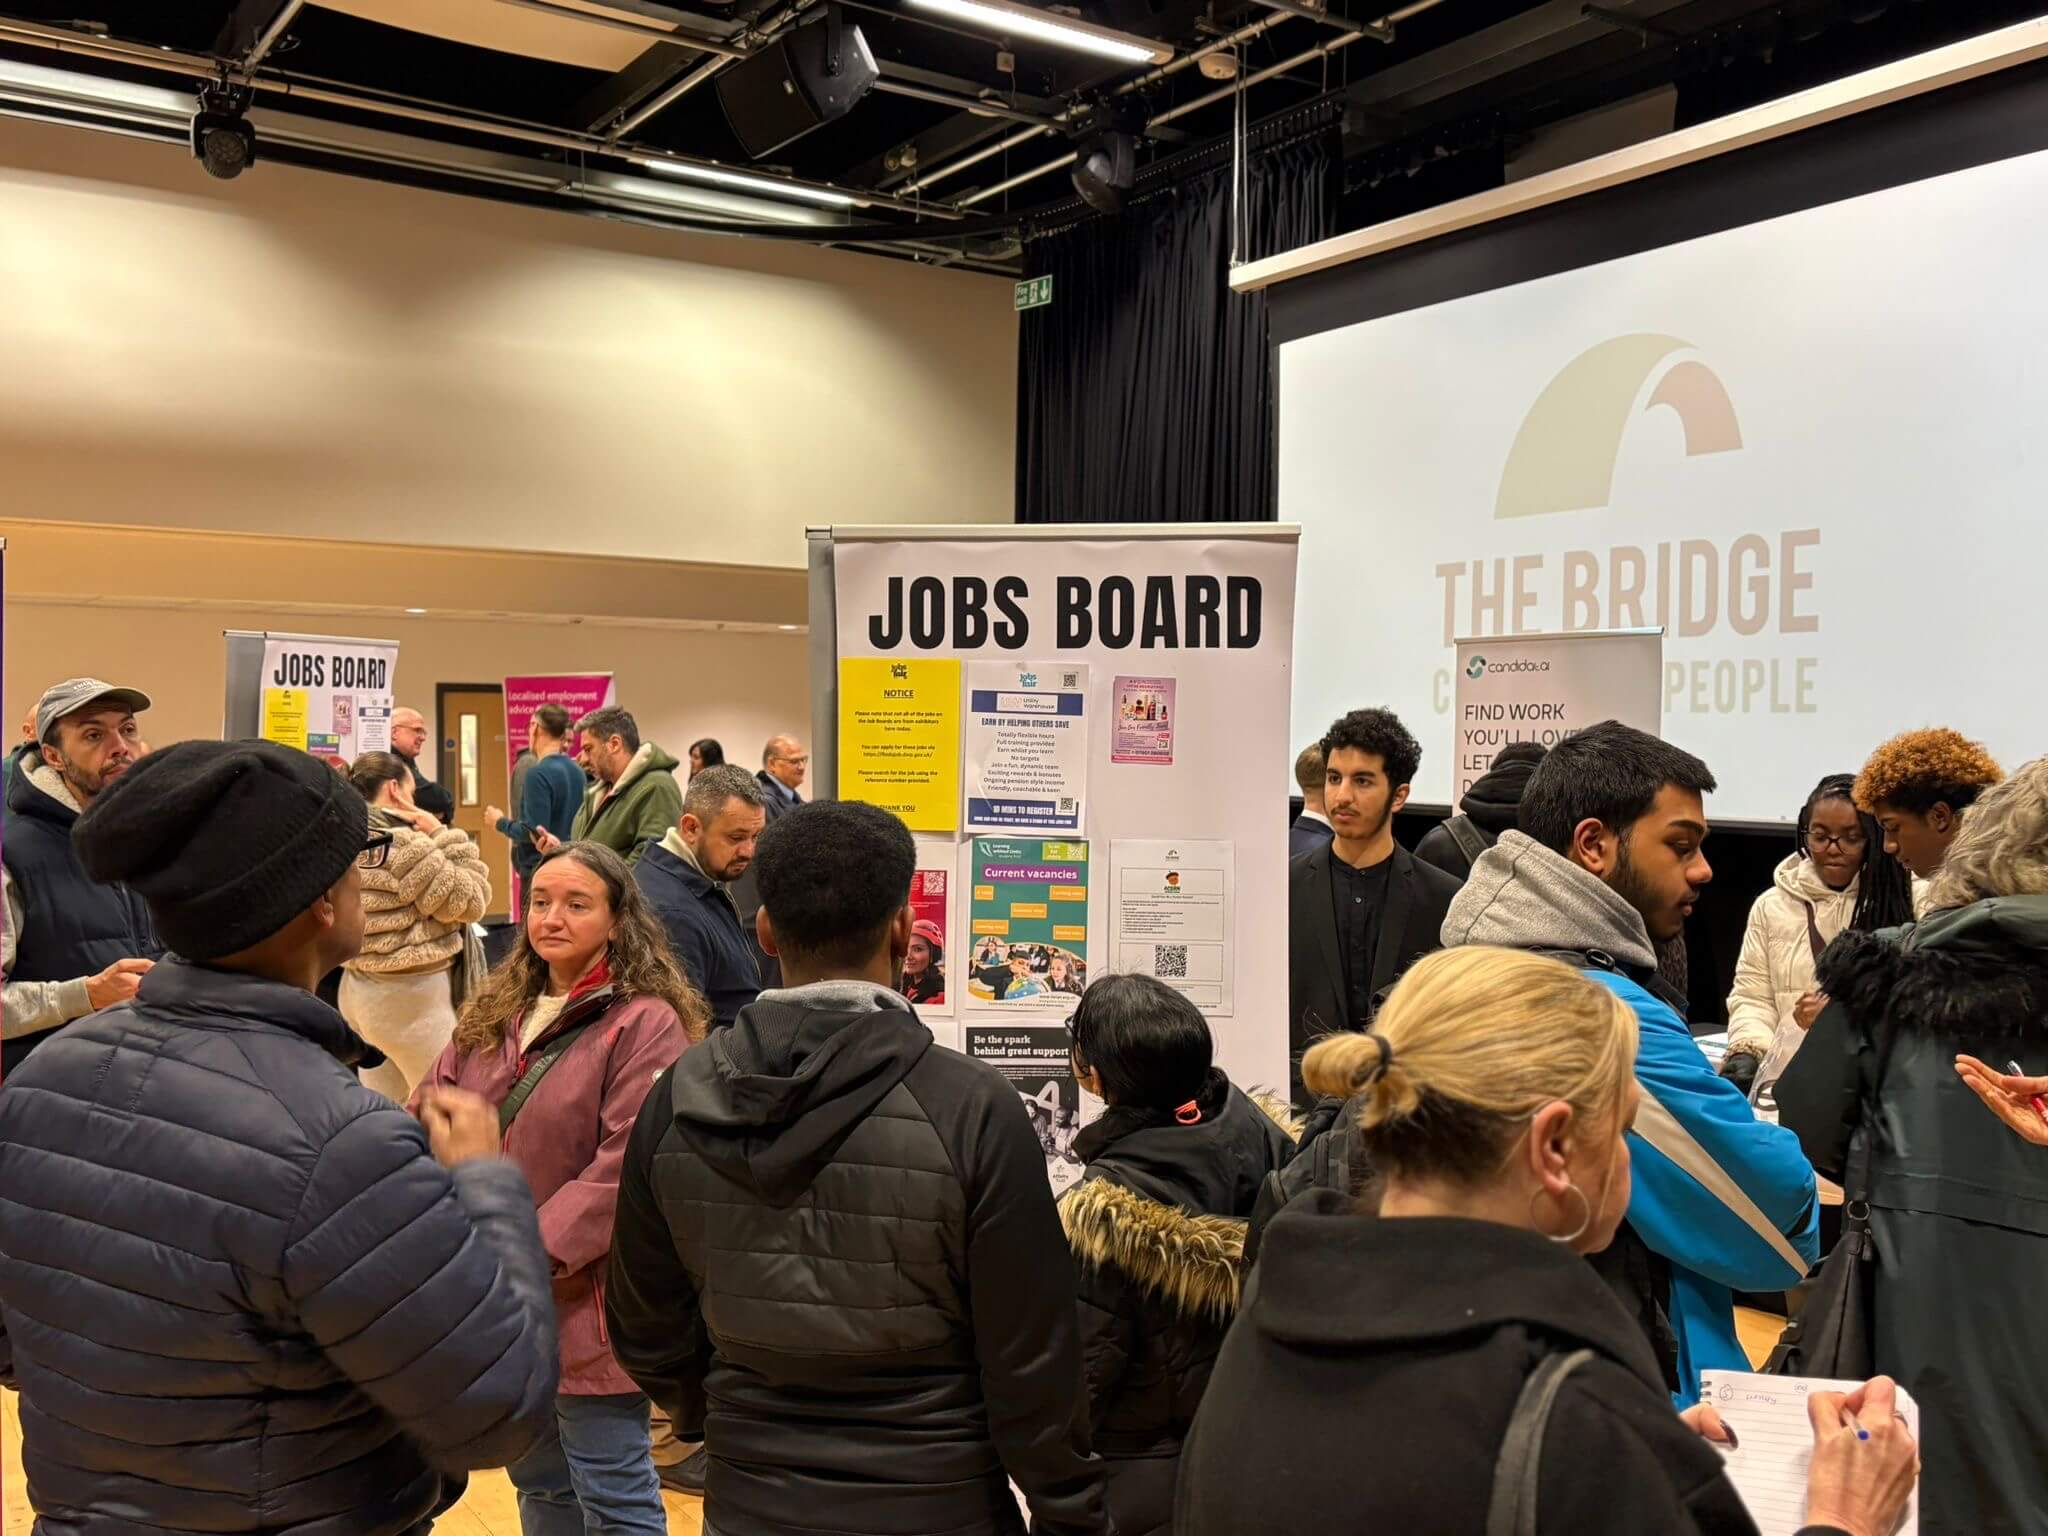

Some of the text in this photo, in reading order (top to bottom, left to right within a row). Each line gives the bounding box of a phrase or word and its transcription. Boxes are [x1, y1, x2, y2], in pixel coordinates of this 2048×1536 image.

[1435, 528, 1820, 648] THE BRIDGE
[868, 575, 1262, 649] JOBS BOARD
[274, 653, 386, 689] JOBS BOARD
[1664, 657, 1817, 713] PEOPLE
[508, 690, 598, 703] Localised employment
[509, 704, 534, 714] advice
[1464, 704, 1565, 720] FIND WORK
[982, 718, 996, 726] EARN
[1007, 719, 1030, 727] HELPING
[1032, 720, 1053, 728] OTHERS
[1018, 806, 1025, 814] TO
[1026, 807, 1053, 815] REGISTER
[985, 868, 1077, 879] Current vacancies
[988, 1035, 1001, 1044] the
[1004, 1035, 1030, 1046] spark
[974, 1047, 1069, 1057] behind great support
